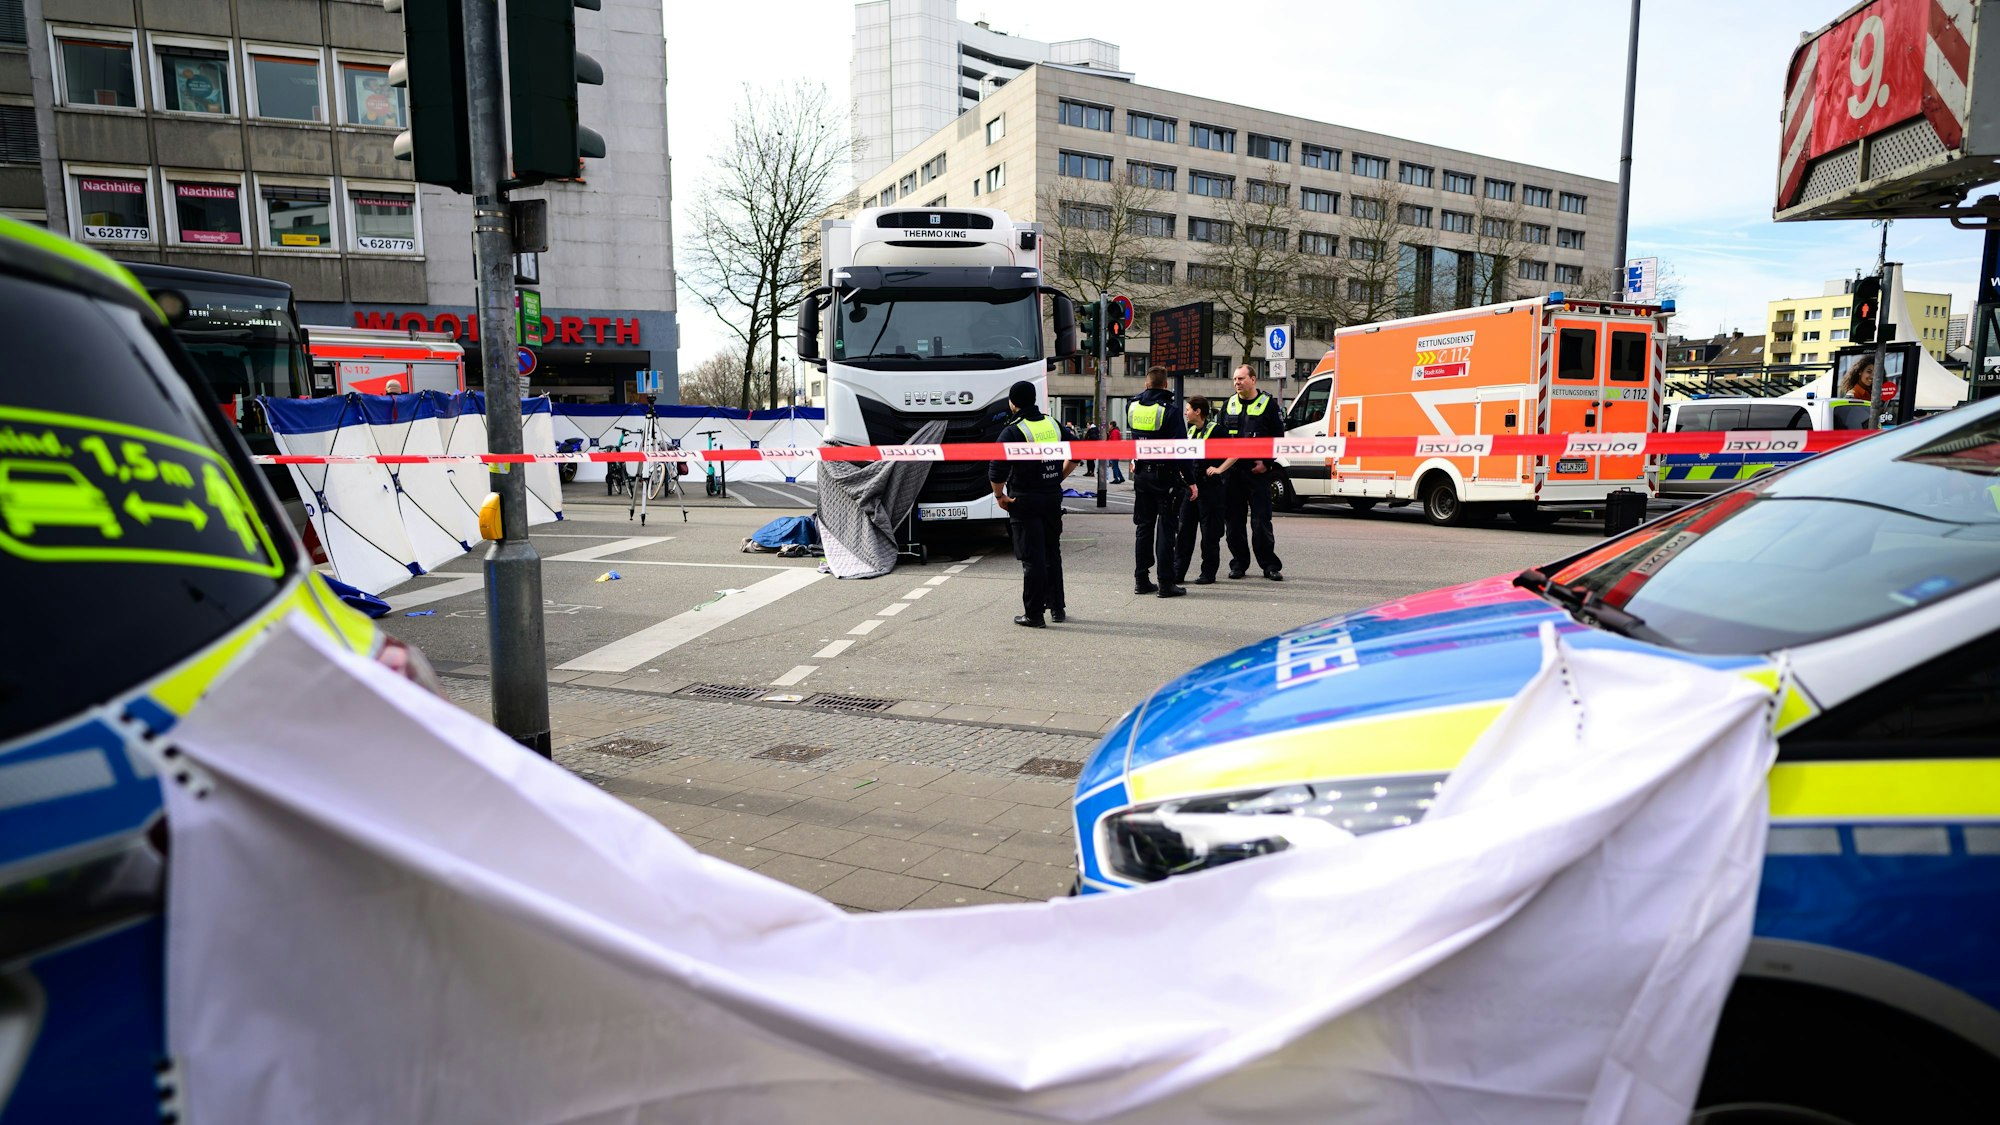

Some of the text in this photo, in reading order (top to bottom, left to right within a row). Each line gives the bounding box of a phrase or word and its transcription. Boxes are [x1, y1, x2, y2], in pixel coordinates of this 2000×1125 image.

[1847, 15, 1890, 119] 9.
[83, 181, 142, 193] Nachhilfe
[179, 186, 235, 198] Nachhilfe
[98, 228, 148, 239] 628779
[944, 230, 967, 238] KING
[370, 239, 414, 250] 628779
[1418, 335, 1474, 348] RETTUNGSDIENST
[1450, 347, 1471, 362] 112
[354, 365, 370, 374] 112
[904, 391, 974, 406] IVECO
[1552, 389, 1598, 397] RETTUNGSDIENST
[1633, 389, 1648, 399] 112
[1035, 430, 1056, 441] POLIZEI
